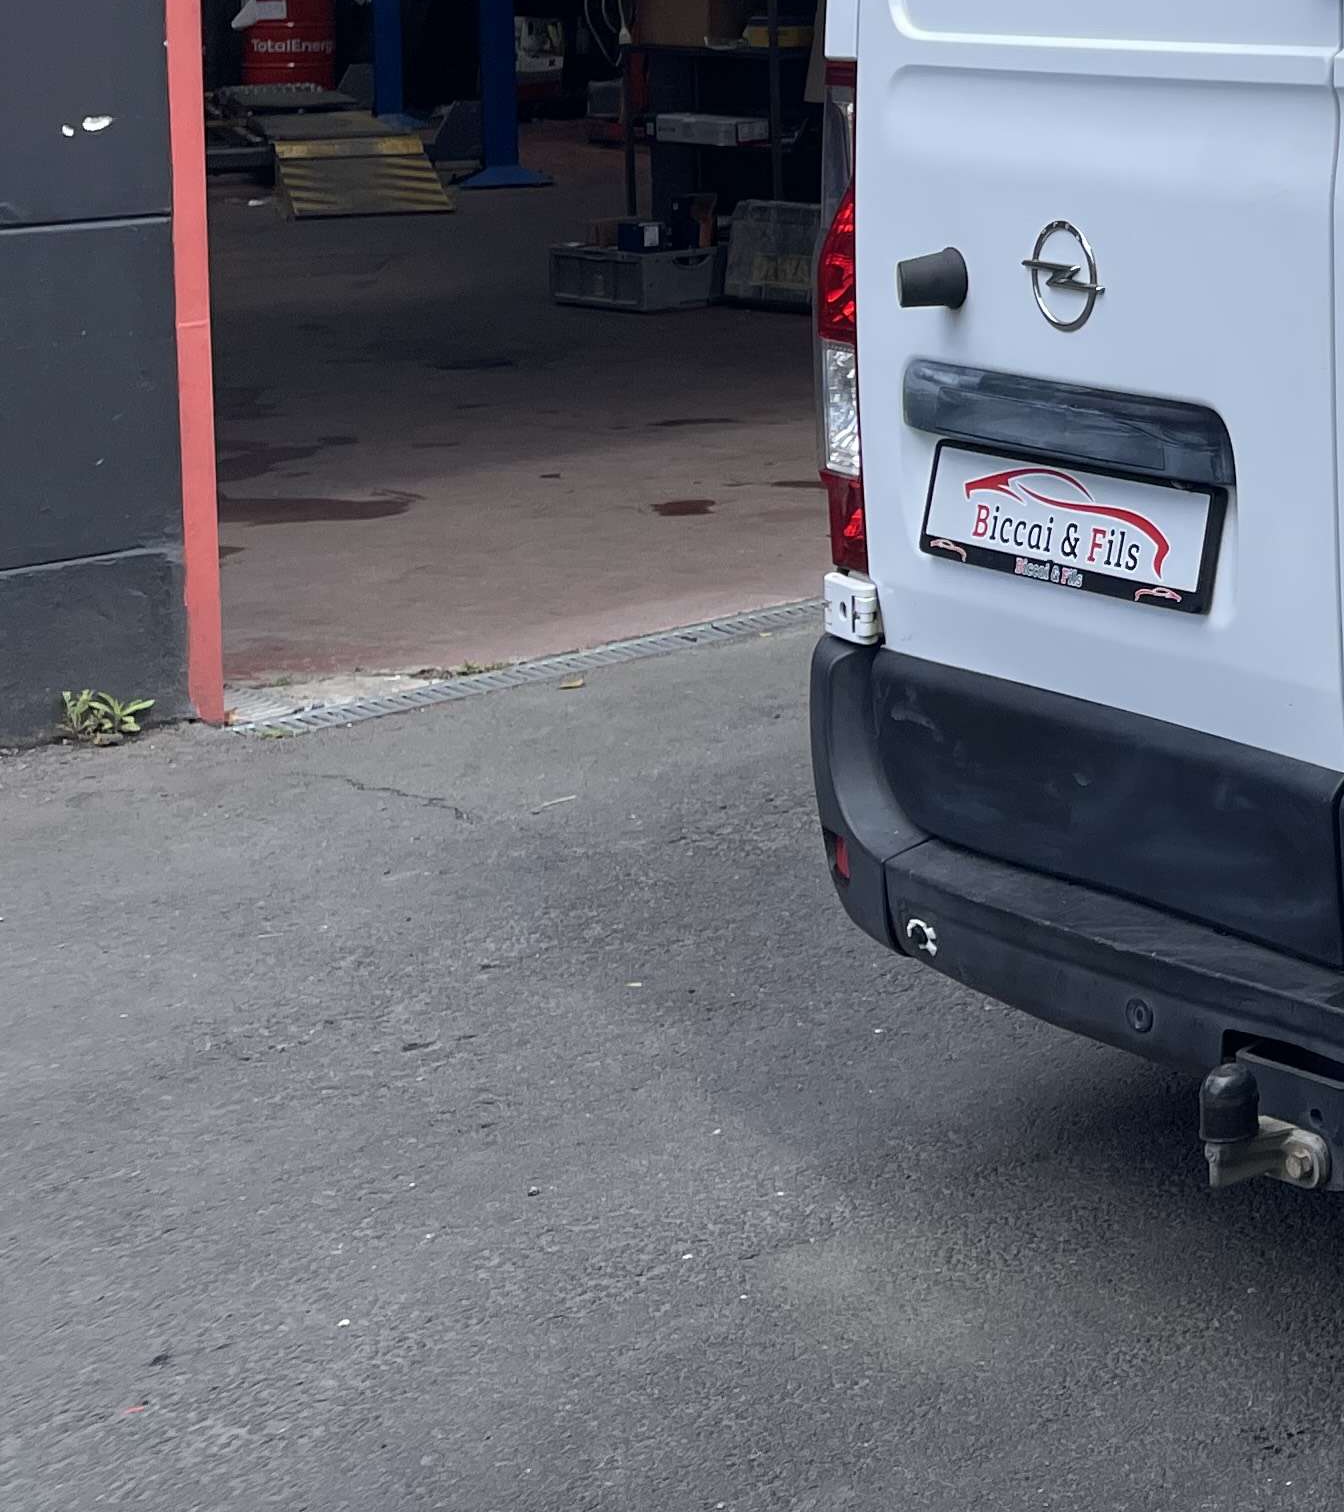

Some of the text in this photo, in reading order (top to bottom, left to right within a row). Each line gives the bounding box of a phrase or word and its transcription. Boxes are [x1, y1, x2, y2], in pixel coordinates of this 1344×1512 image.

[972, 504, 1140, 571] Biccai & Fils
